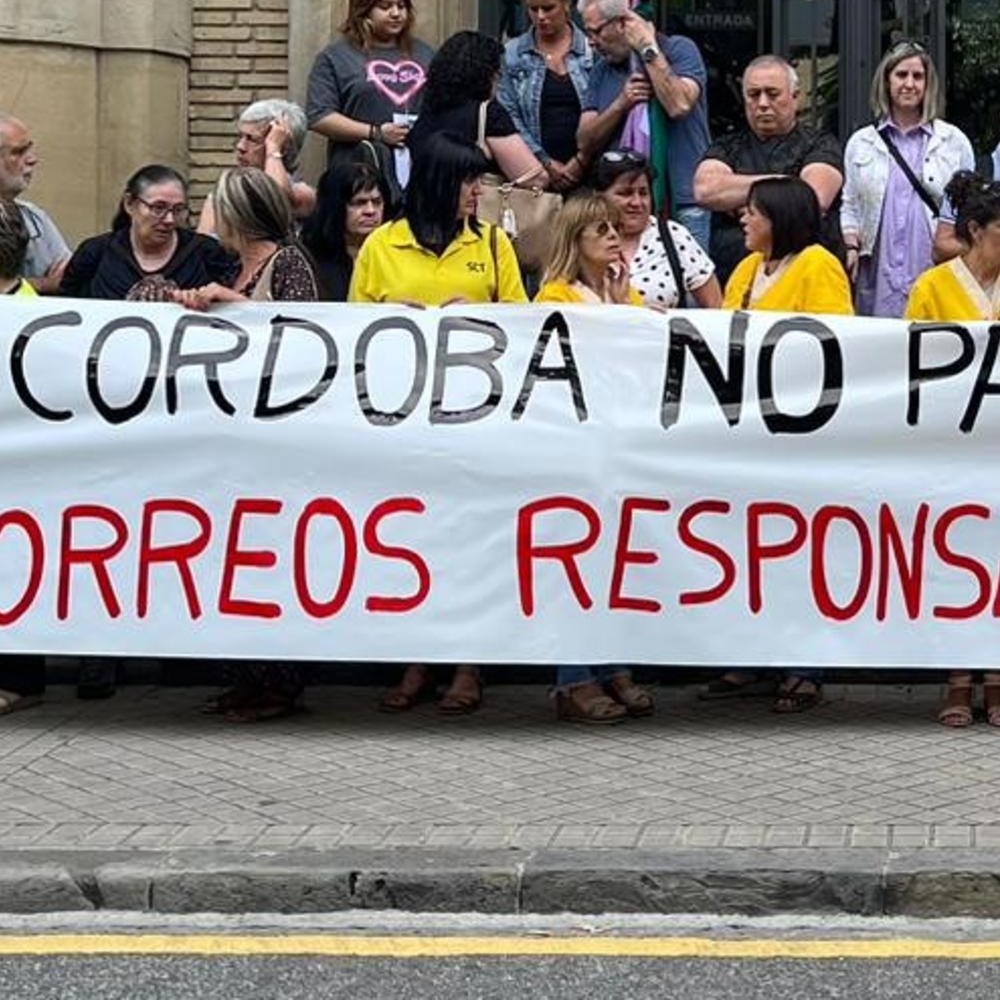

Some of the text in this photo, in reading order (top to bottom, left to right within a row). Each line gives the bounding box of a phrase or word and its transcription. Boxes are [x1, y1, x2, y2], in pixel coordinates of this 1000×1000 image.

[685, 13, 754, 29] ENTRADA
[10, 309, 588, 426] CORDOBA
[660, 310, 845, 435] NO
